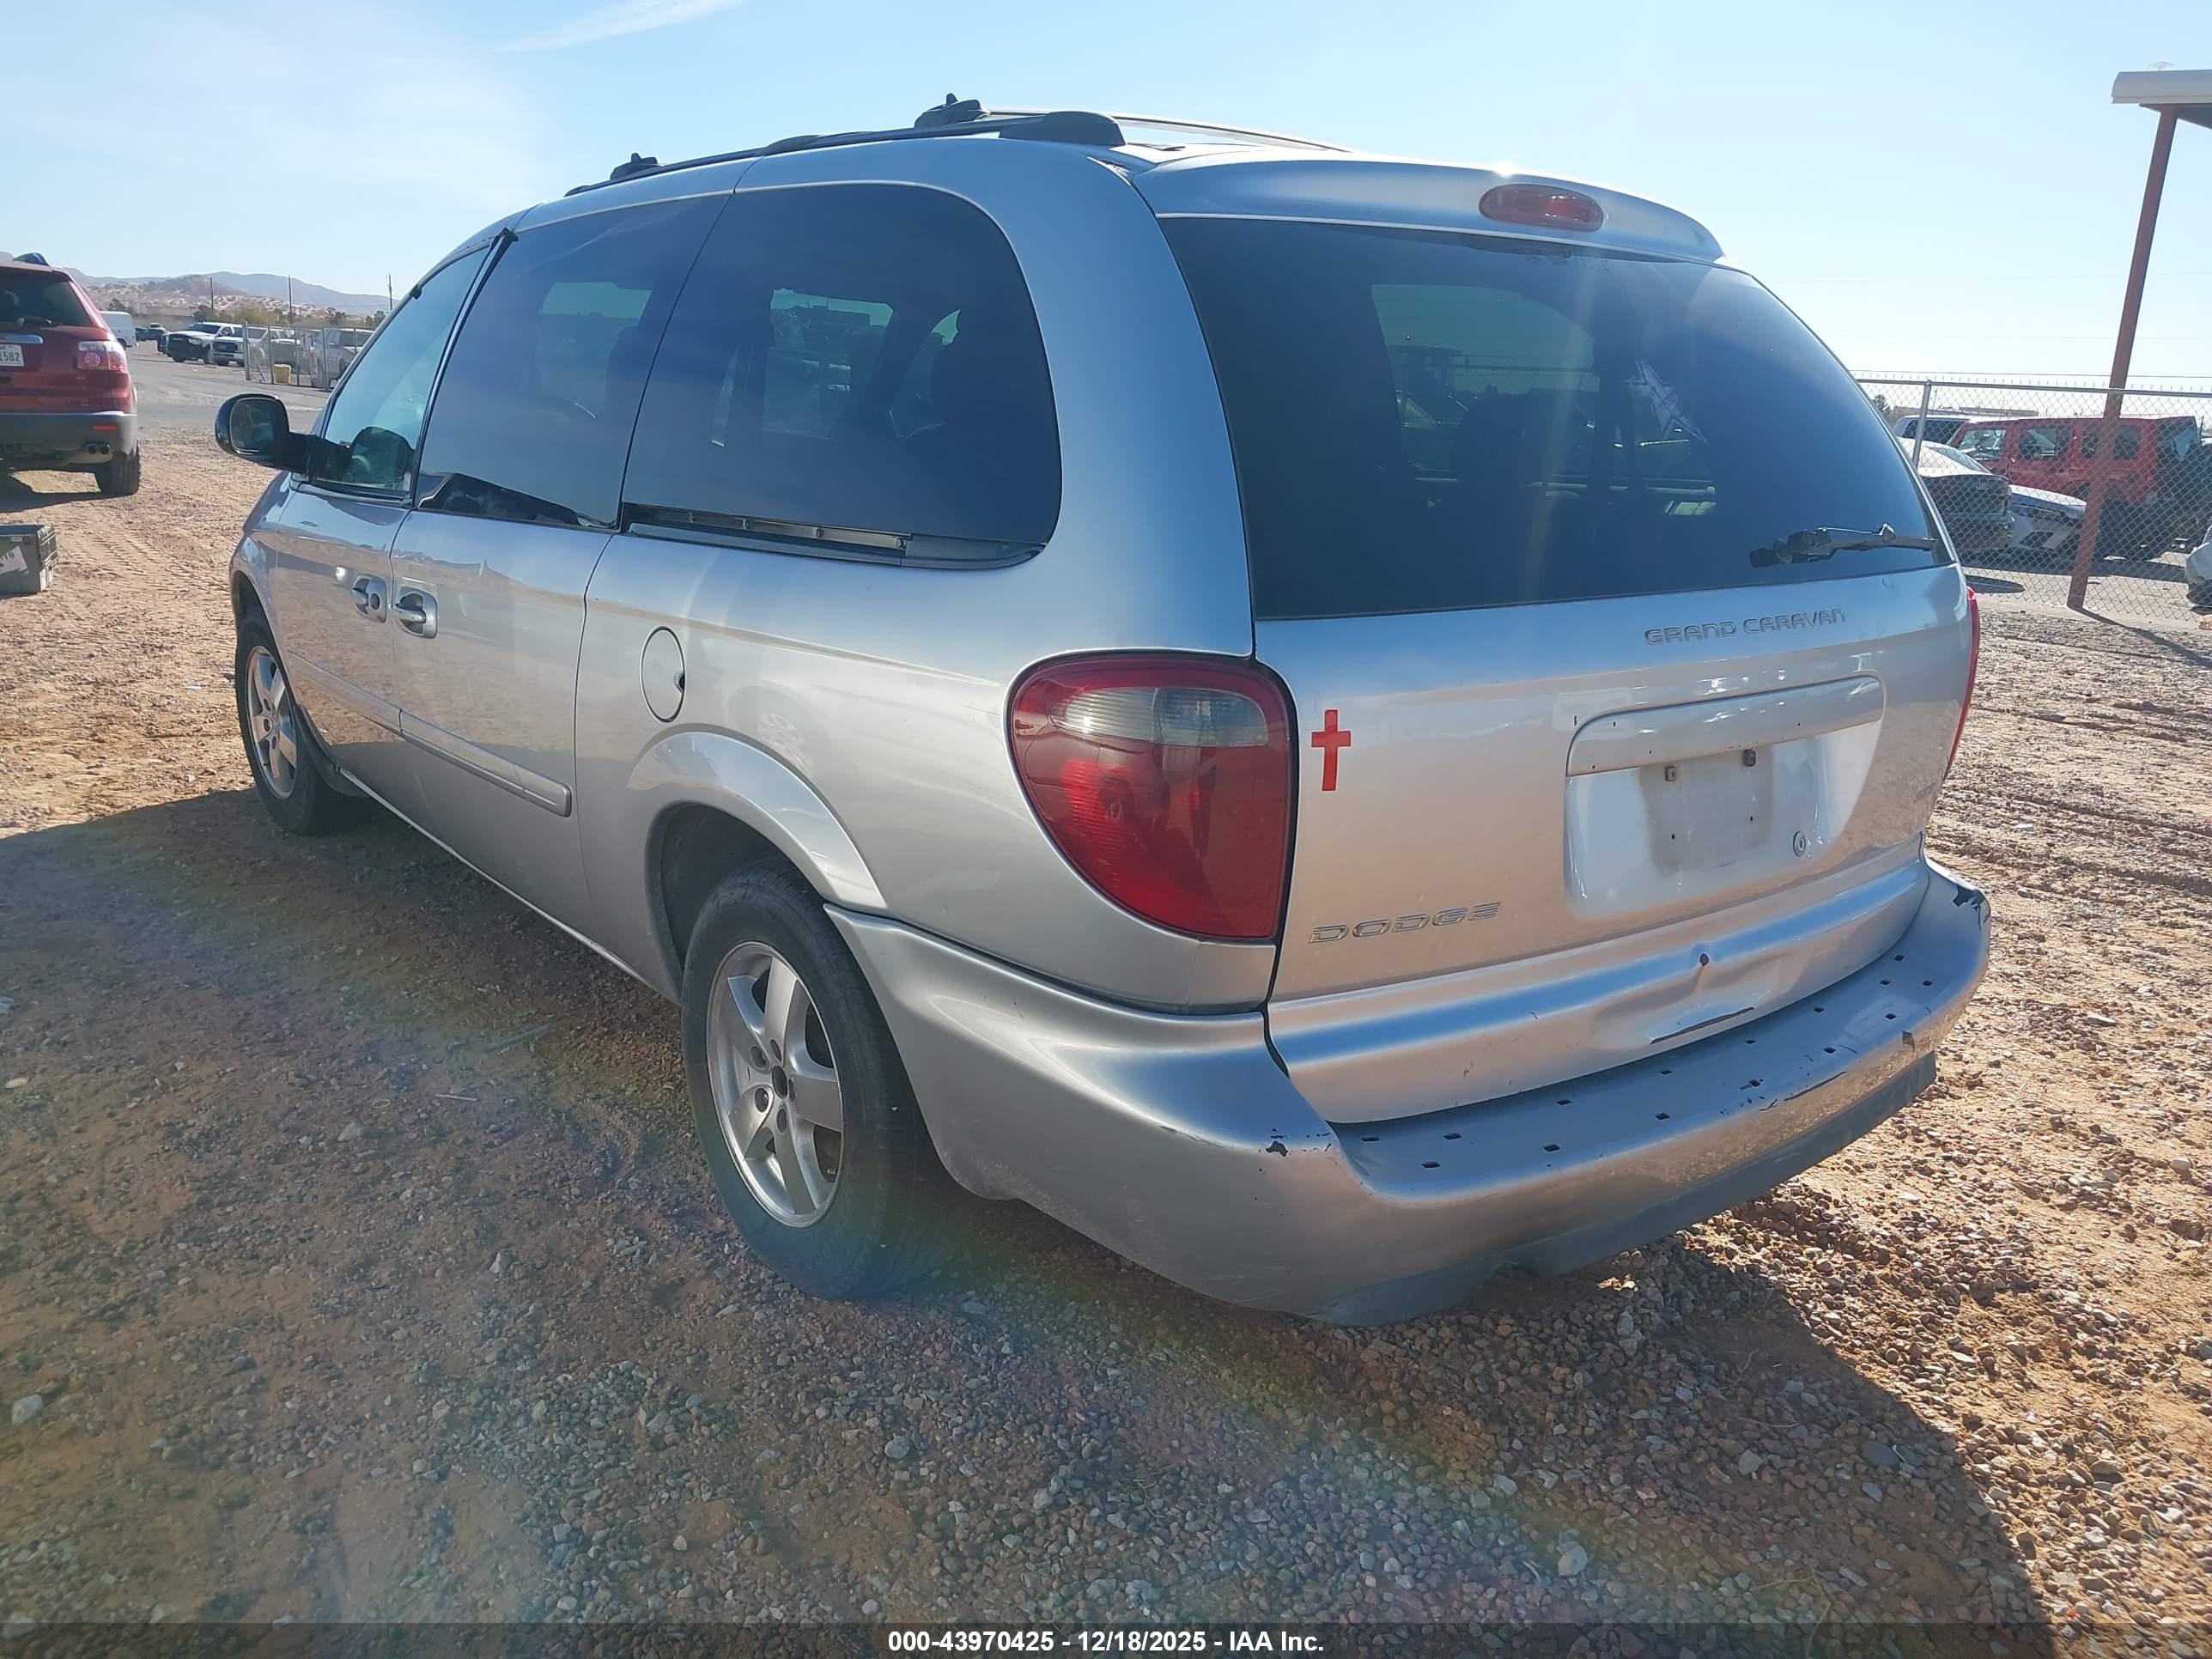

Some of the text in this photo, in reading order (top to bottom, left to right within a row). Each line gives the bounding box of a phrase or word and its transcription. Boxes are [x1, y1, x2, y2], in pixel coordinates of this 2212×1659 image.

[1644, 608, 1845, 645] GRAND CARAVAN
[1308, 902, 1501, 944] DODGE
